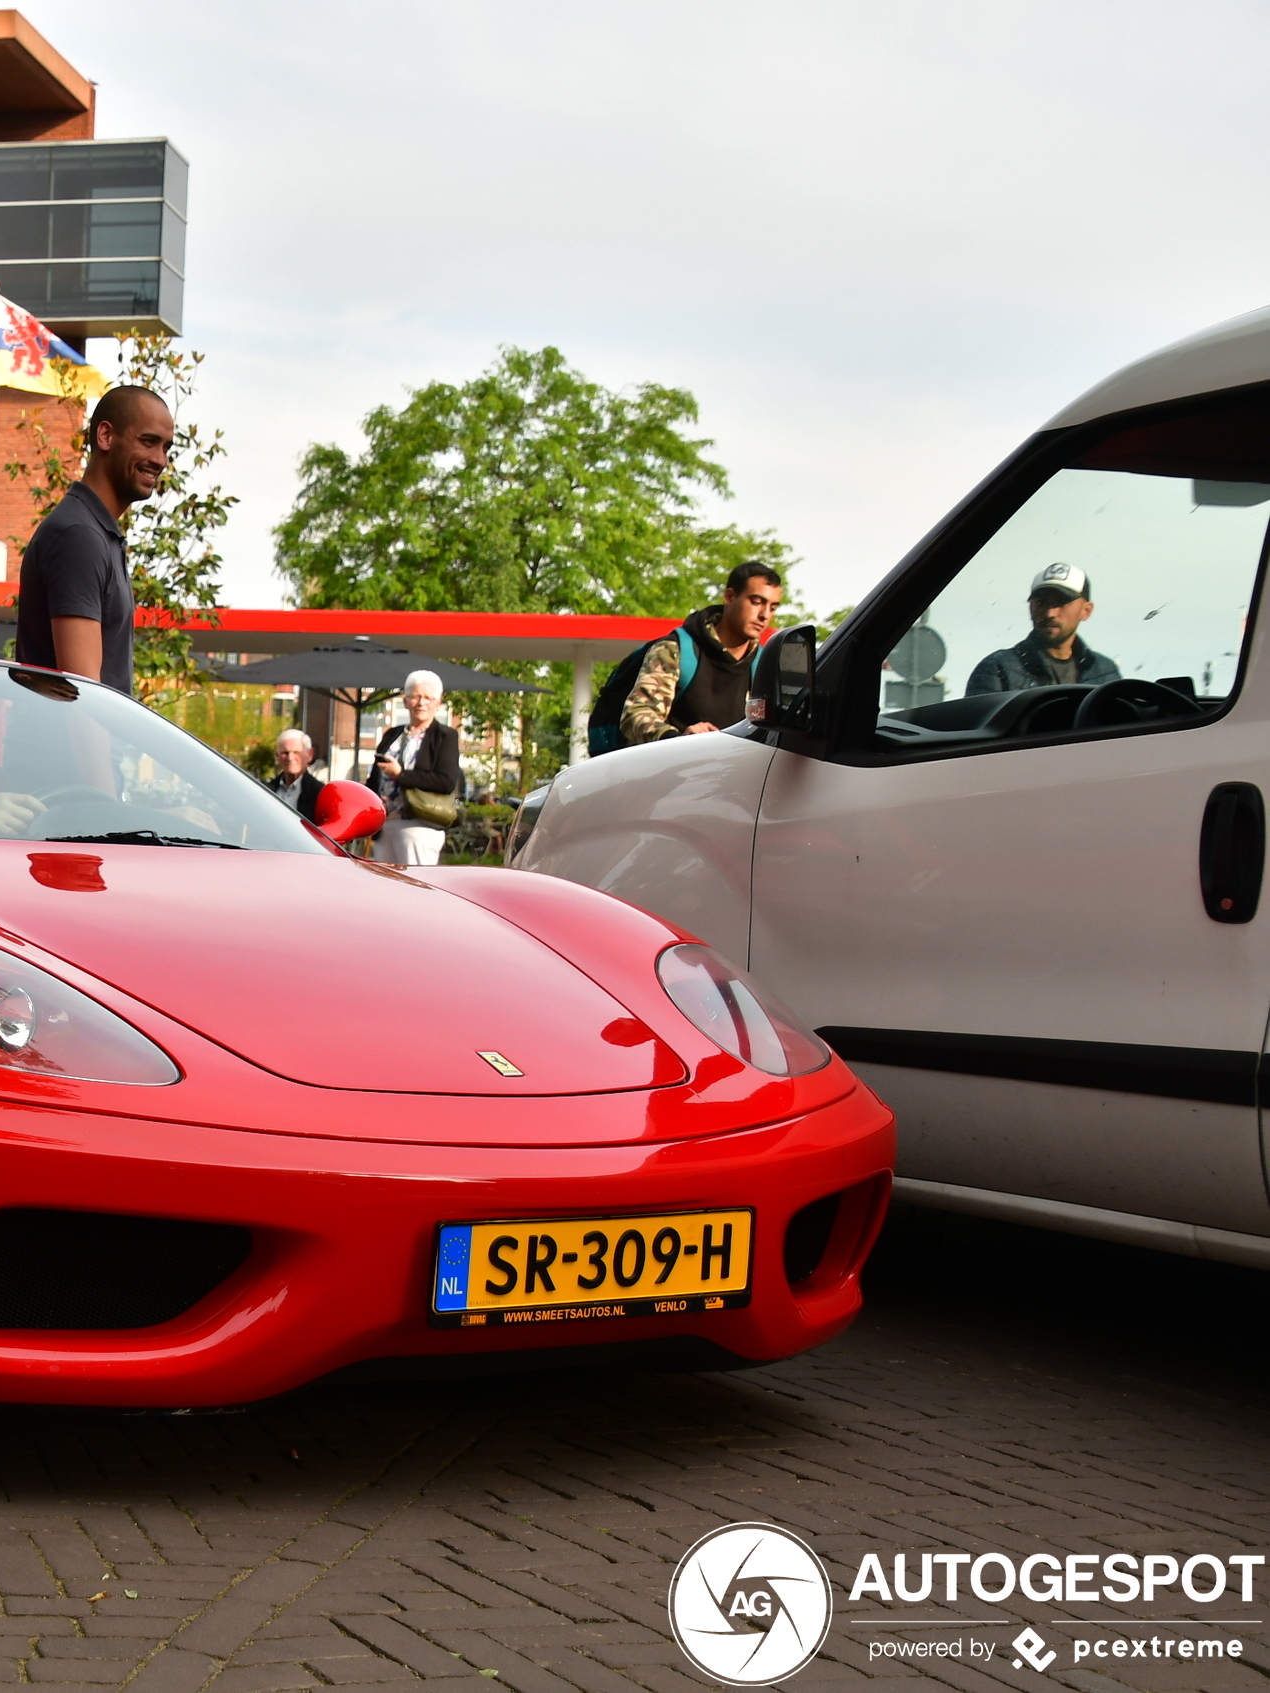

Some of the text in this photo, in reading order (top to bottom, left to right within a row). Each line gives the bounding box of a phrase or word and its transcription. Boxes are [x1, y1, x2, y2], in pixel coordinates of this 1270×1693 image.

[485, 1222, 733, 1296] SR-309-H
[441, 1277, 464, 1296] NL
[503, 1300, 687, 1323] WWW.SMEETSAUTOS.NL VENLO
